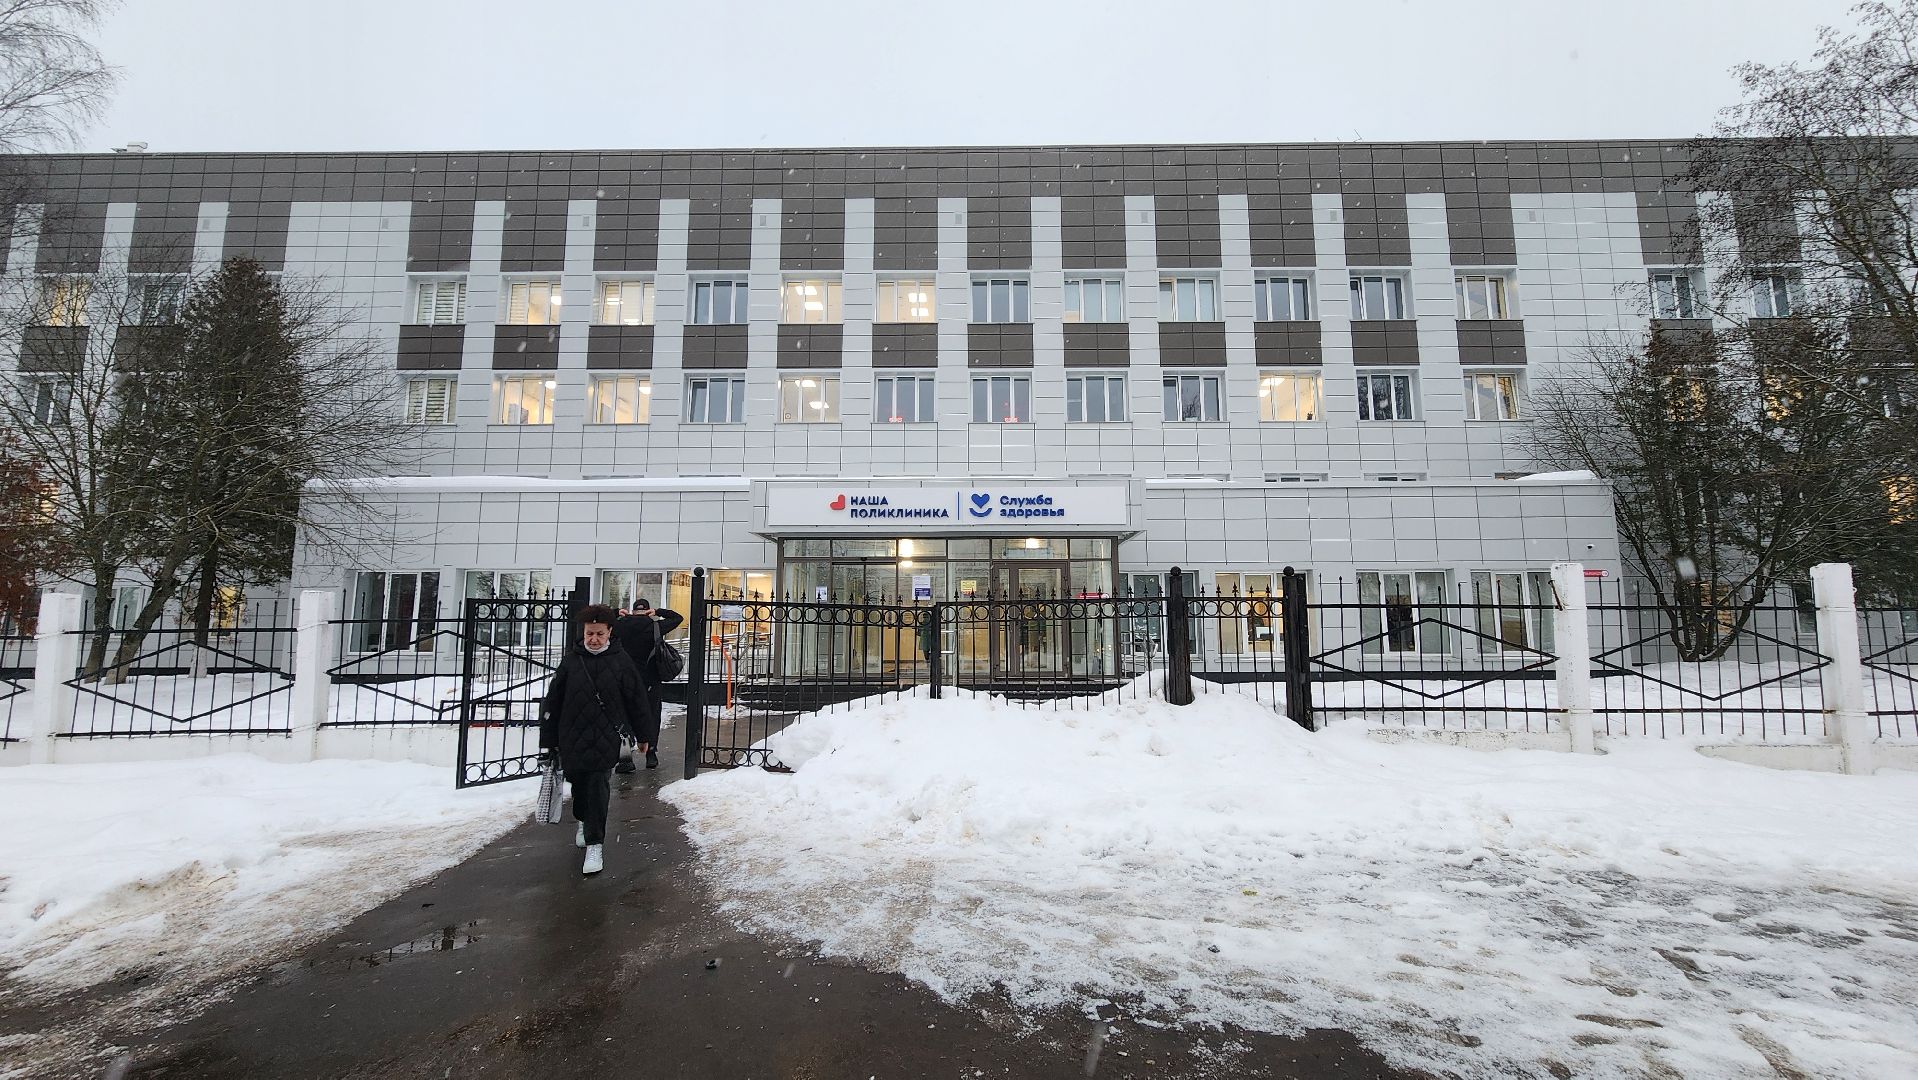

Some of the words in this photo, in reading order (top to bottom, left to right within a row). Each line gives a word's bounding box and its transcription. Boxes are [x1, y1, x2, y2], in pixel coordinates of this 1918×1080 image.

[850, 495, 889, 506] НАША
[999, 494, 1053, 508] Служба
[850, 508, 949, 519] ПОЛИКЛИНИКА
[999, 508, 1065, 519] здоровья
